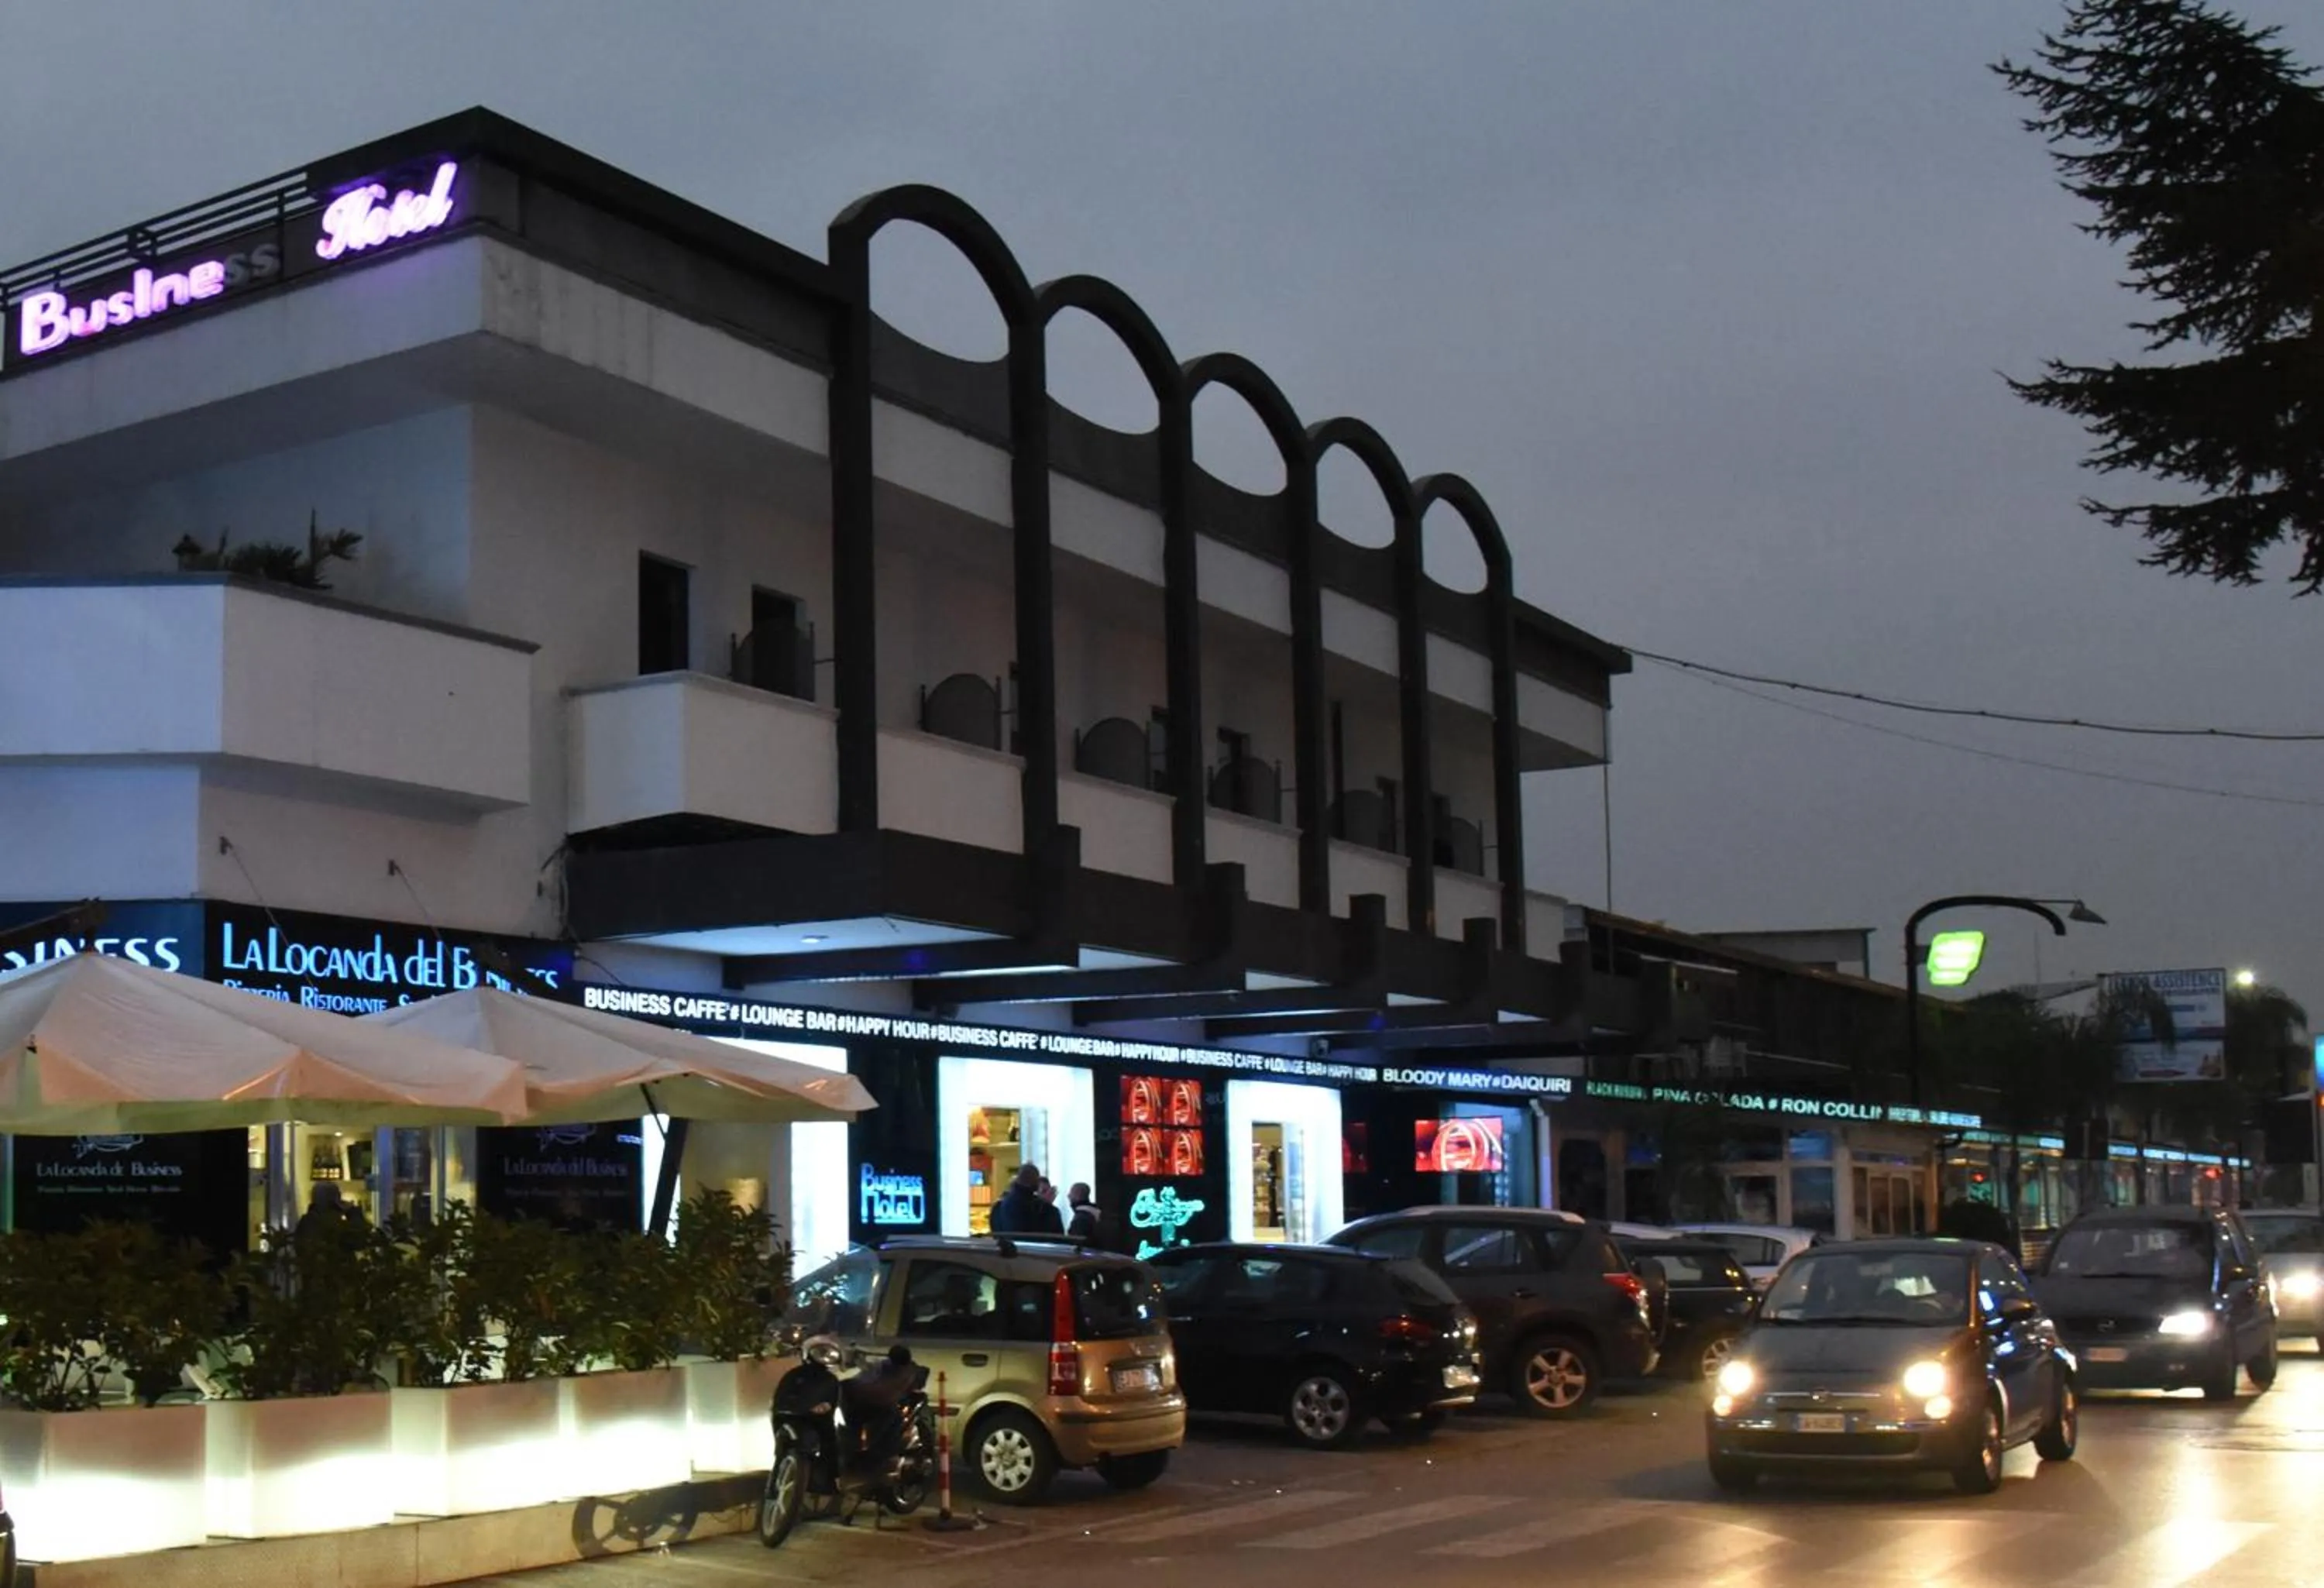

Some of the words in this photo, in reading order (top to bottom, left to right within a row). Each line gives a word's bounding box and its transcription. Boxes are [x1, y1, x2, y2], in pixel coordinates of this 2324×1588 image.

[585, 987, 670, 1016] BUSINESS
[741, 1004, 804, 1029] LOUNGE
[1383, 1068, 1445, 1085] BLOODY
[1782, 1098, 1820, 1115] RON
